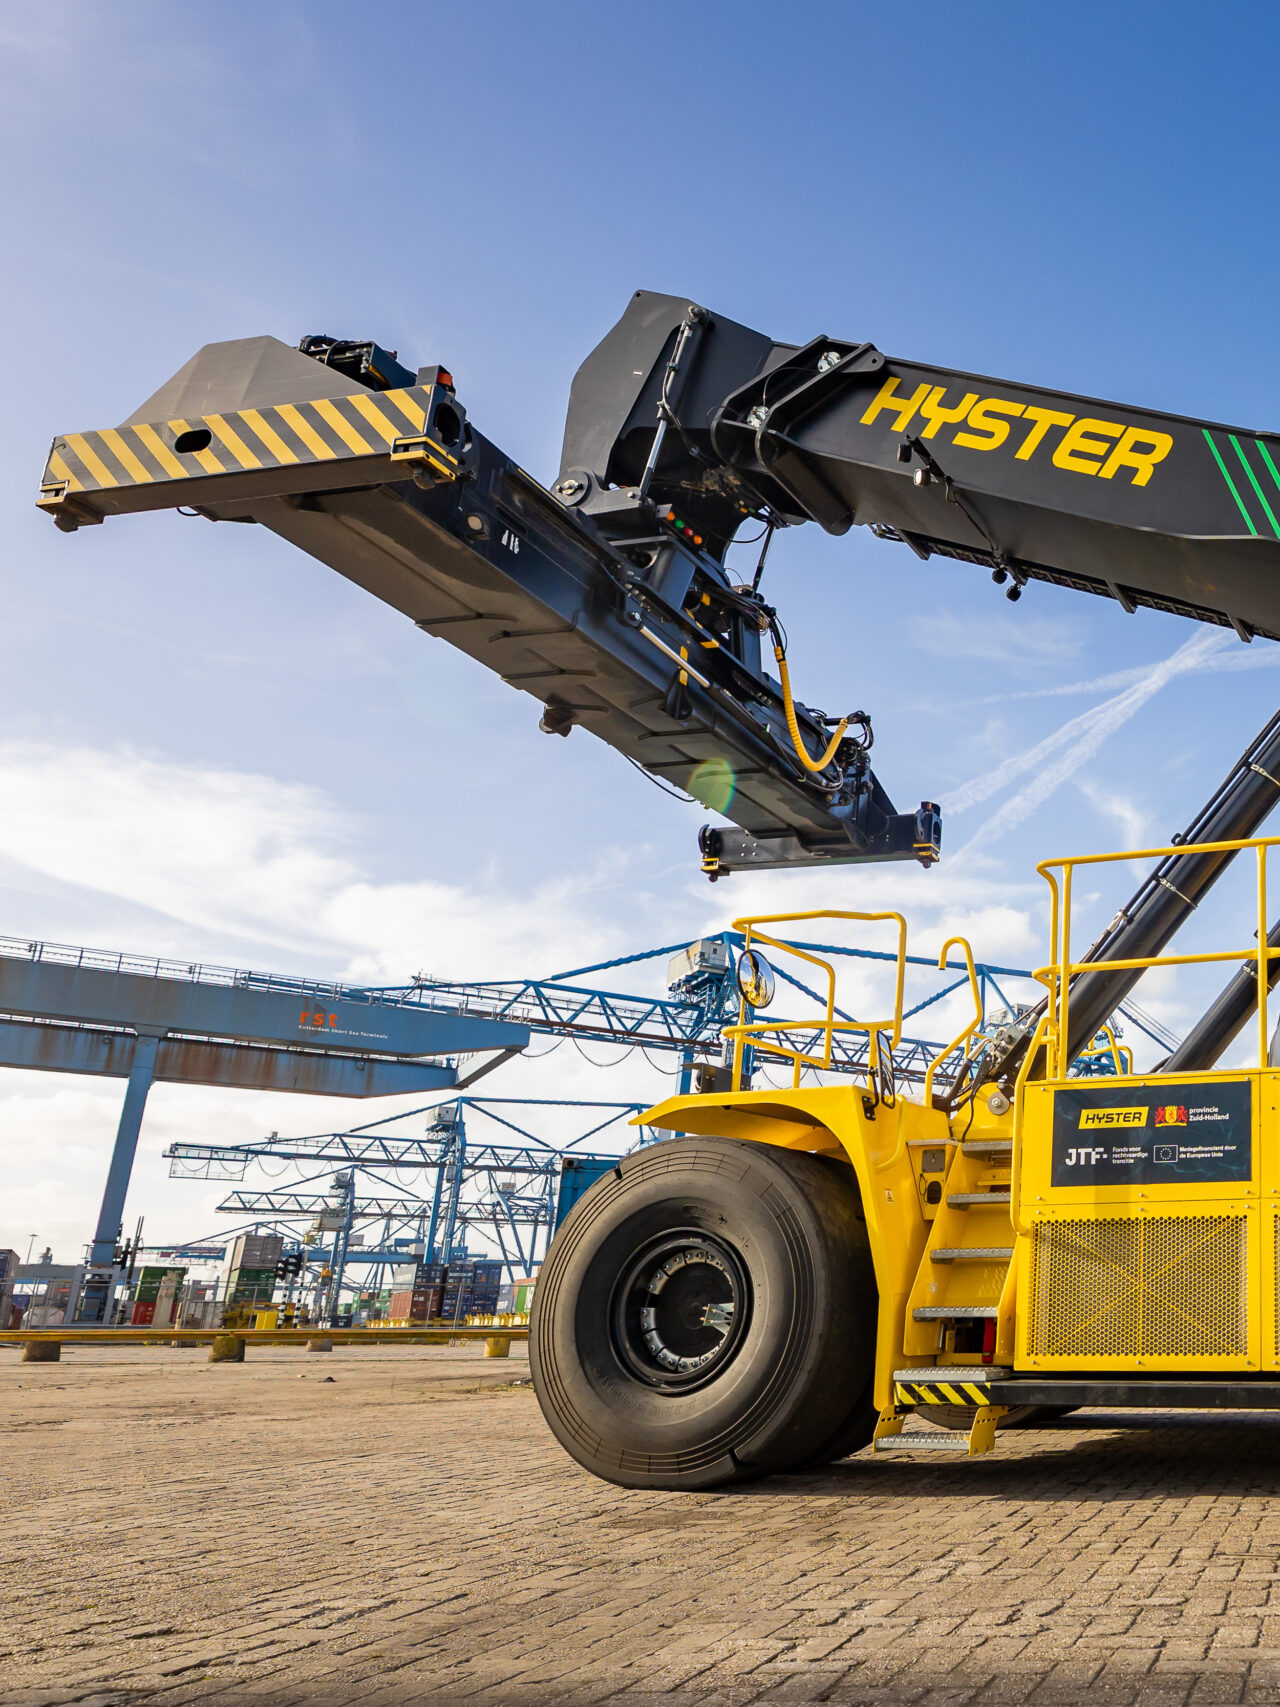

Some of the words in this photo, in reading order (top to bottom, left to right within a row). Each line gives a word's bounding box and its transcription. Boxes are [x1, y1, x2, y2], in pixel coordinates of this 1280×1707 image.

[859, 377, 1174, 487] HYSTER
[1189, 1106, 1219, 1115] provincie
[1085, 1112, 1142, 1124] HYSTER
[1189, 1113, 1230, 1122] Zuid-Holland
[1065, 1148, 1105, 1166] JTF
